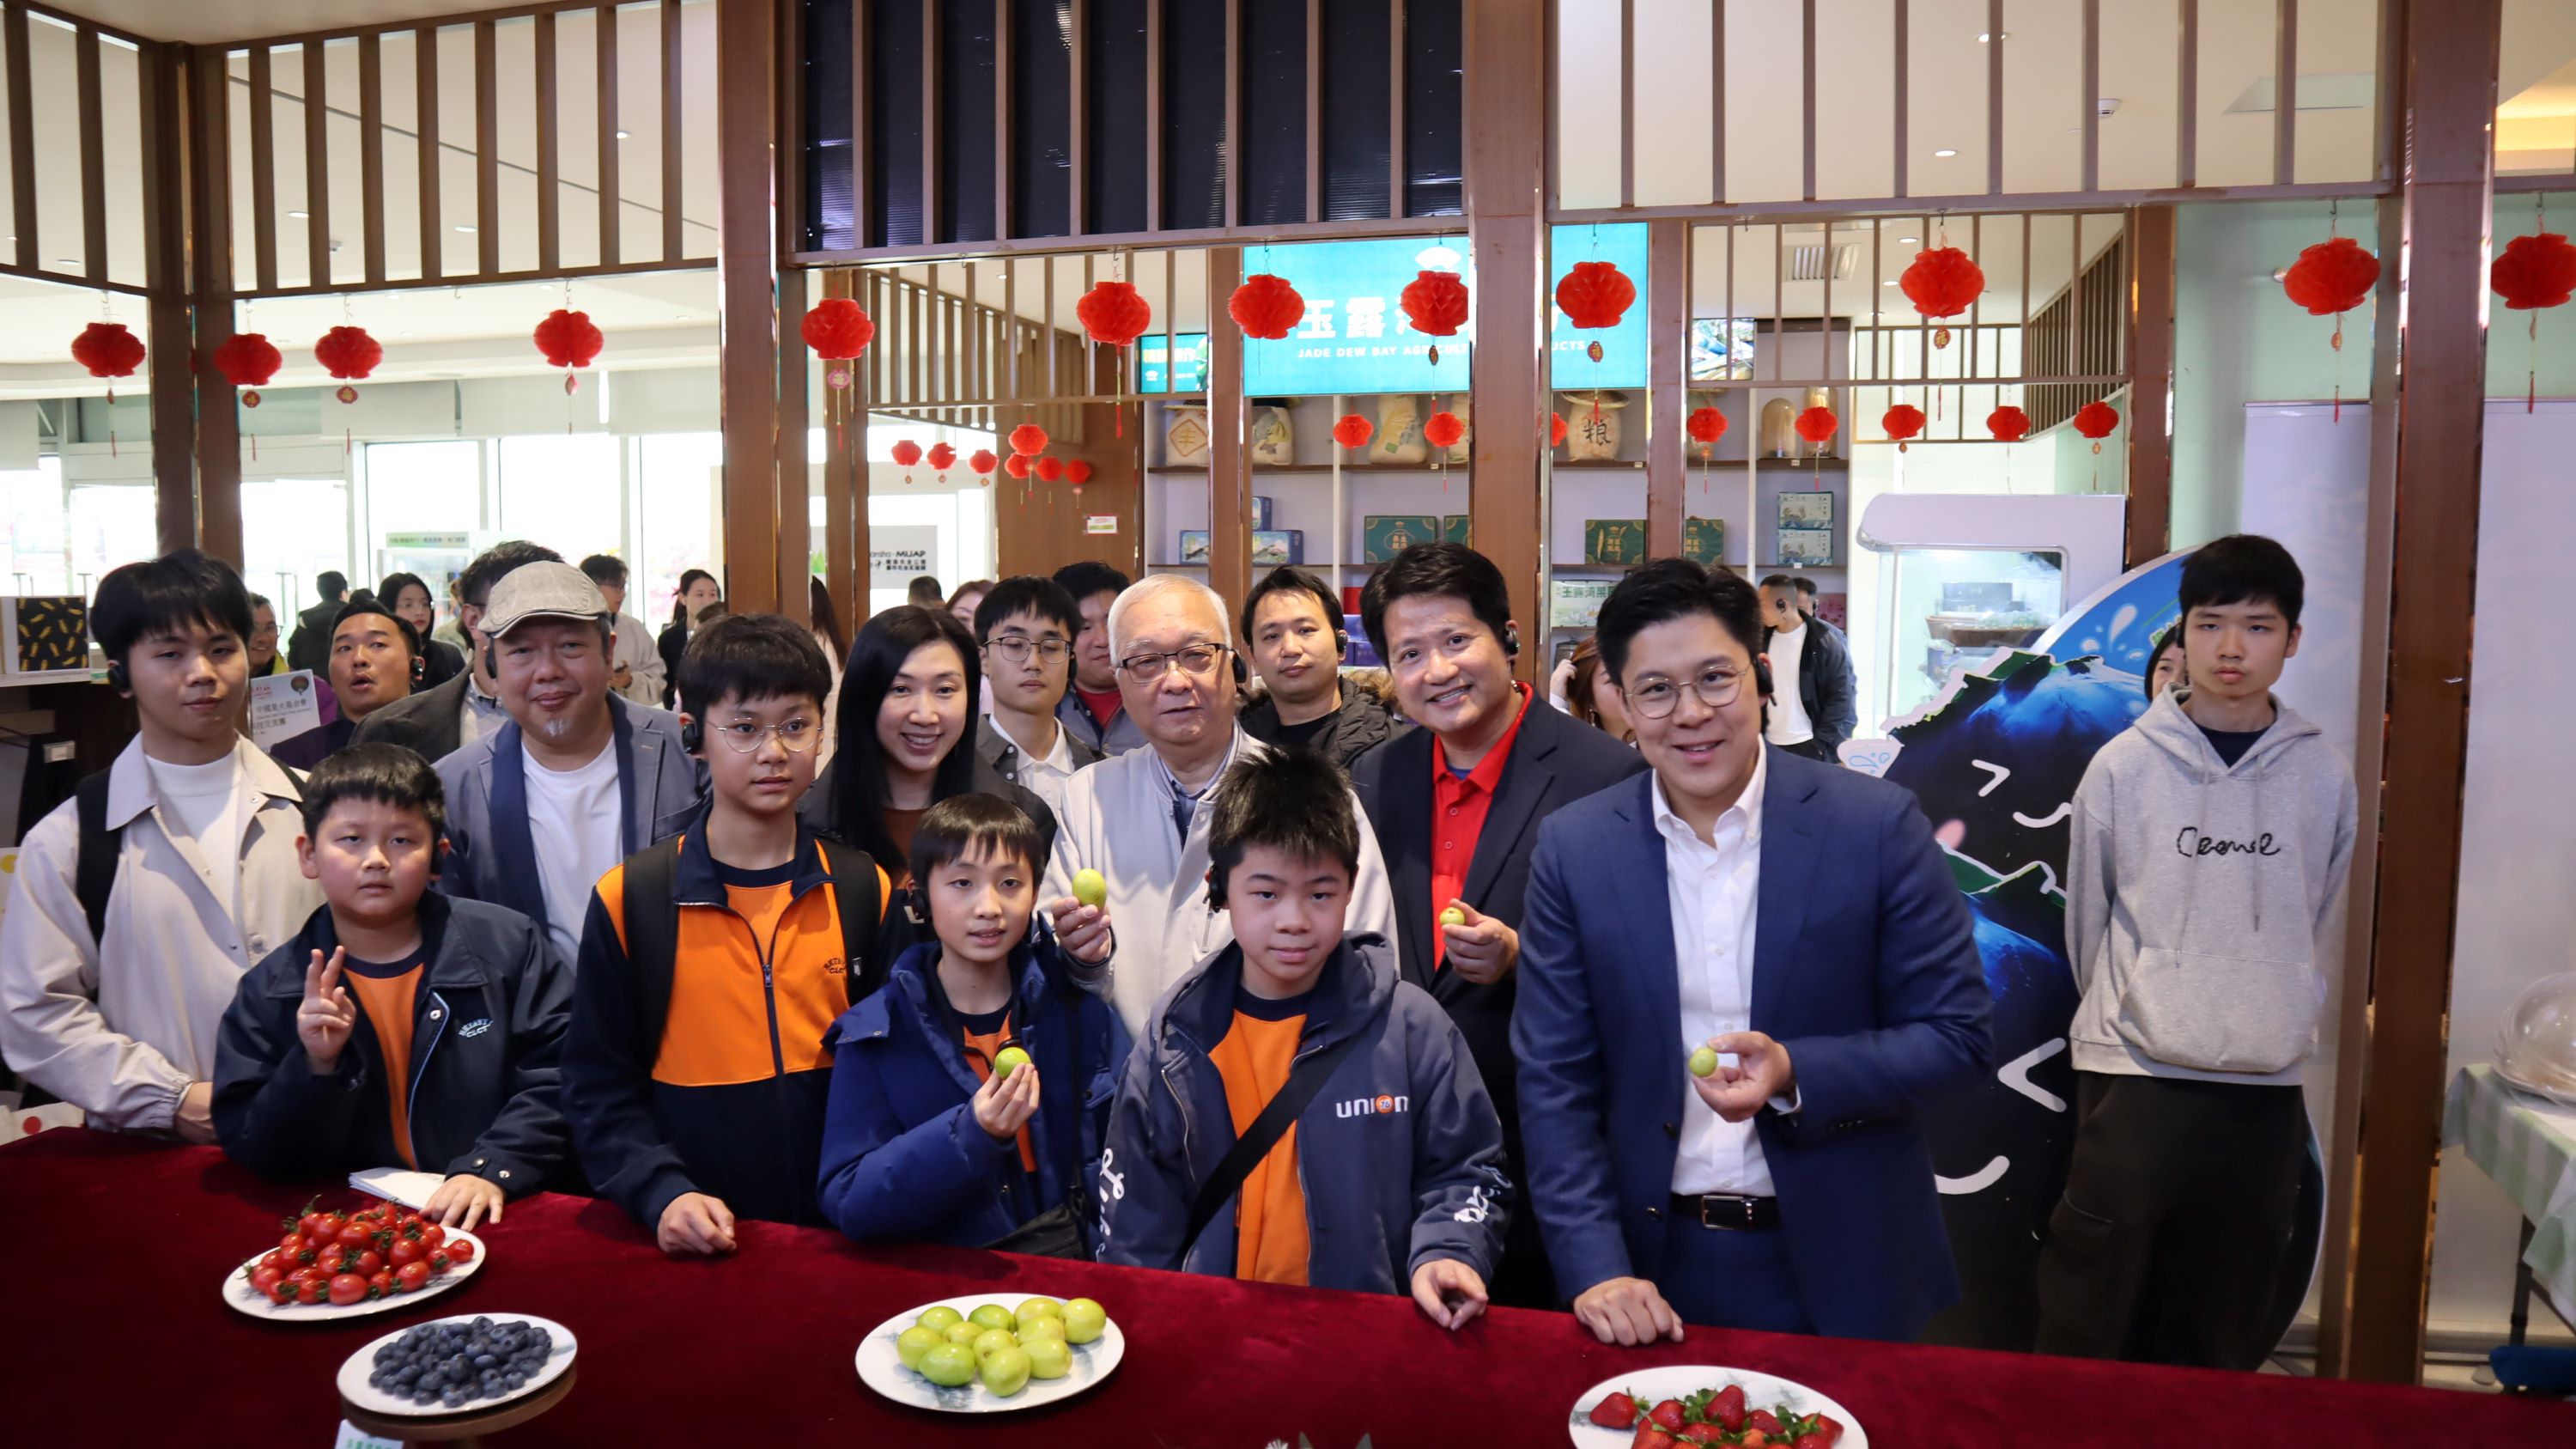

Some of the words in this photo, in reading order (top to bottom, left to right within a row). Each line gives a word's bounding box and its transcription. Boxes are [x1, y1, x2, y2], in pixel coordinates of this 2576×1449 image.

[1297, 348, 1331, 358] JADE
[1336, 347, 1366, 357] DEW
[1371, 346, 1398, 357] BAY
[1403, 344, 1468, 355] AGRCULT
